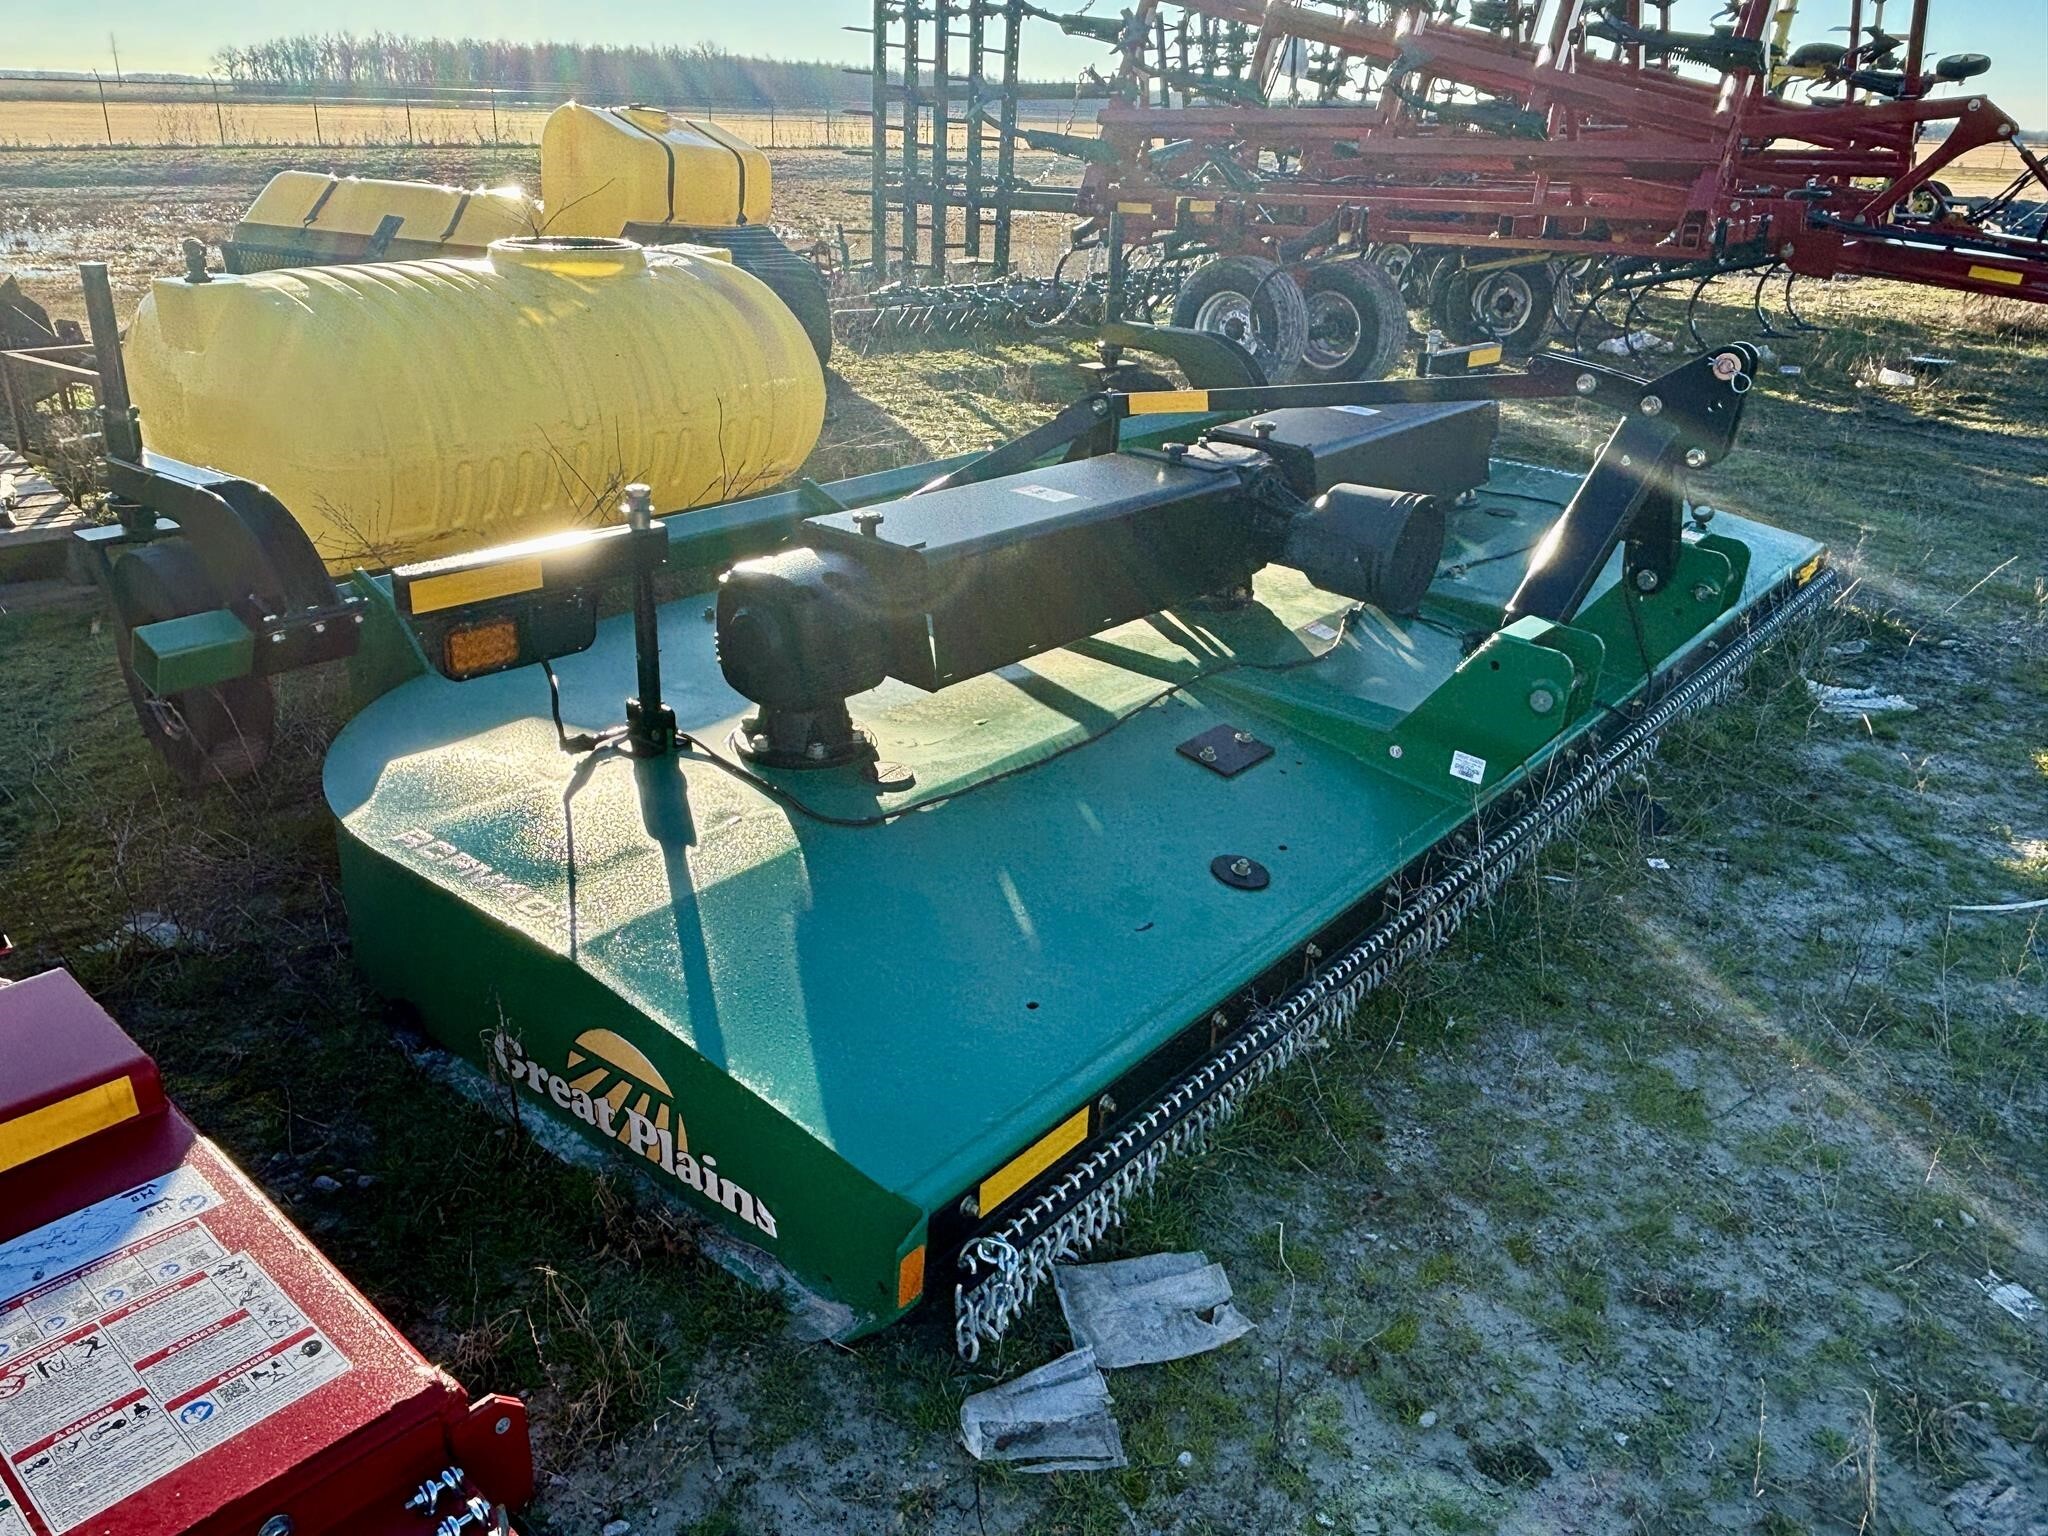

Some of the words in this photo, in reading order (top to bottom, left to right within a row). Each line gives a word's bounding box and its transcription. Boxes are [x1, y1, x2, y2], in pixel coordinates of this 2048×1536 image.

[493, 1032, 618, 1137] Great
[624, 1106, 778, 1240] Plains
[140, 1284, 182, 1305] DANGER
[178, 1323, 223, 1347] DANGER
[21, 1340, 67, 1365] DANGER
[228, 1351, 273, 1378] DANGER
[66, 1405, 114, 1435] DANGER
